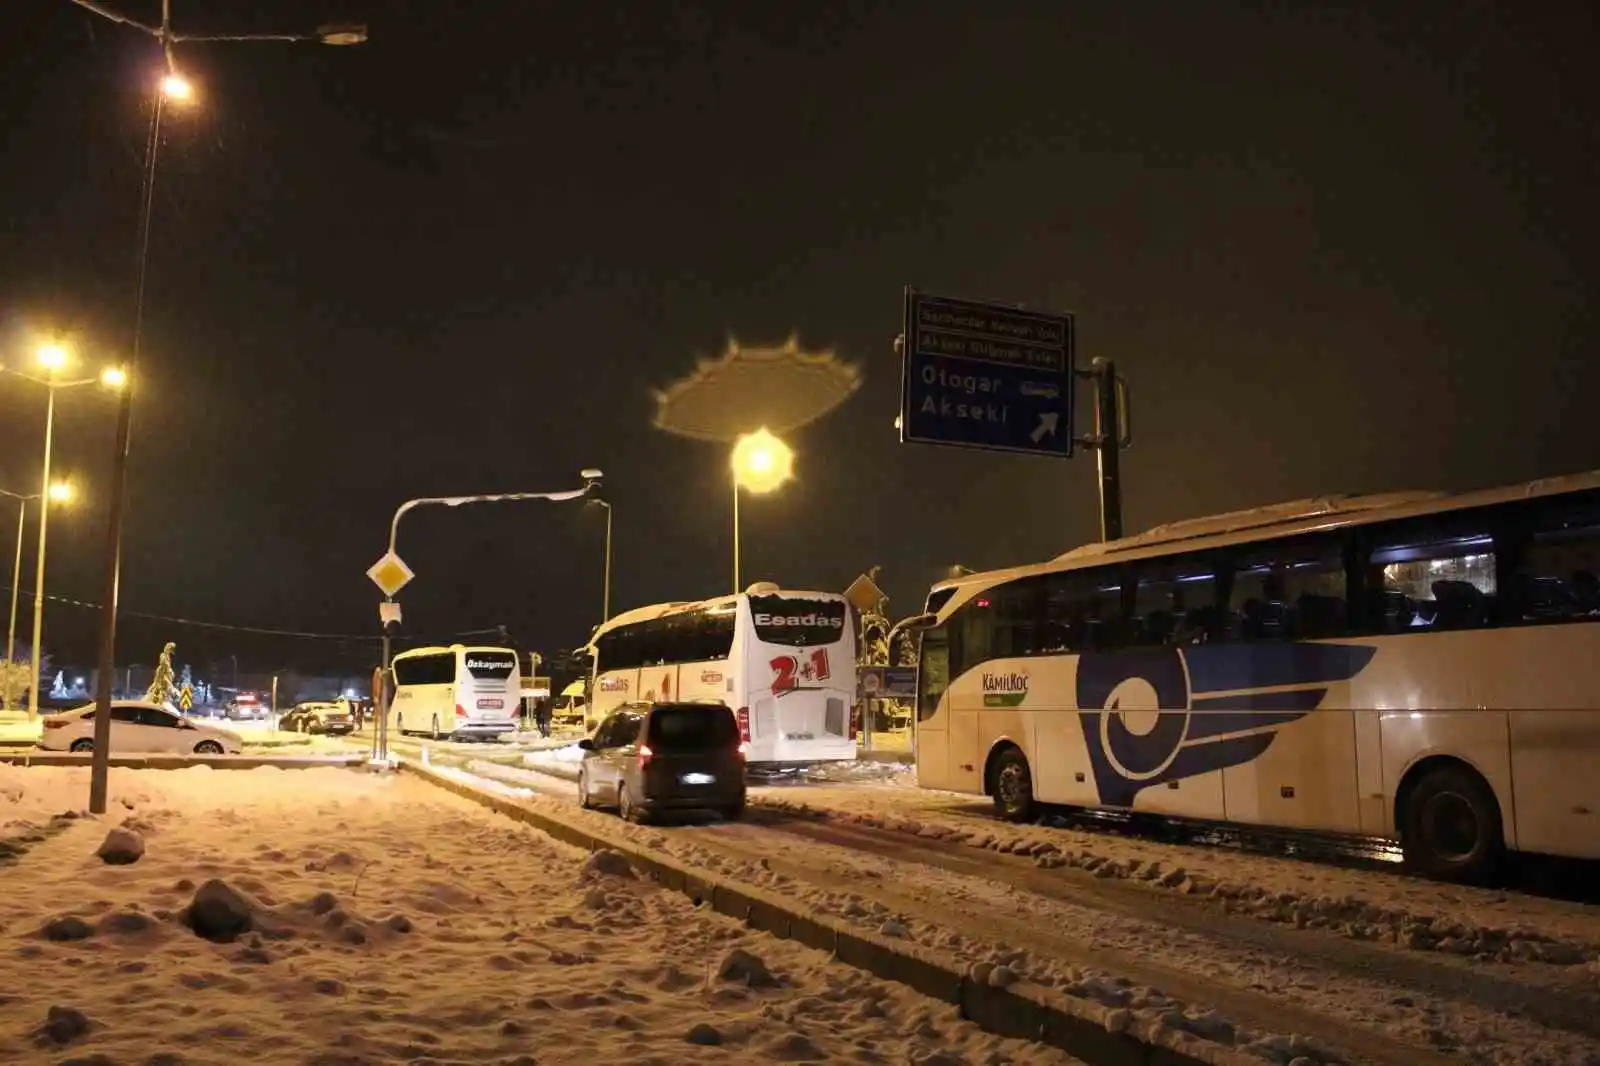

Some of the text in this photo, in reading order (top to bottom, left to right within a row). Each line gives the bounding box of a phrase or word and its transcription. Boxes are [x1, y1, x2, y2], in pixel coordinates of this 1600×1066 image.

[921, 365, 1002, 393] Otogar
[921, 396, 1009, 424] Akseki
[769, 648, 831, 697] 2+1
